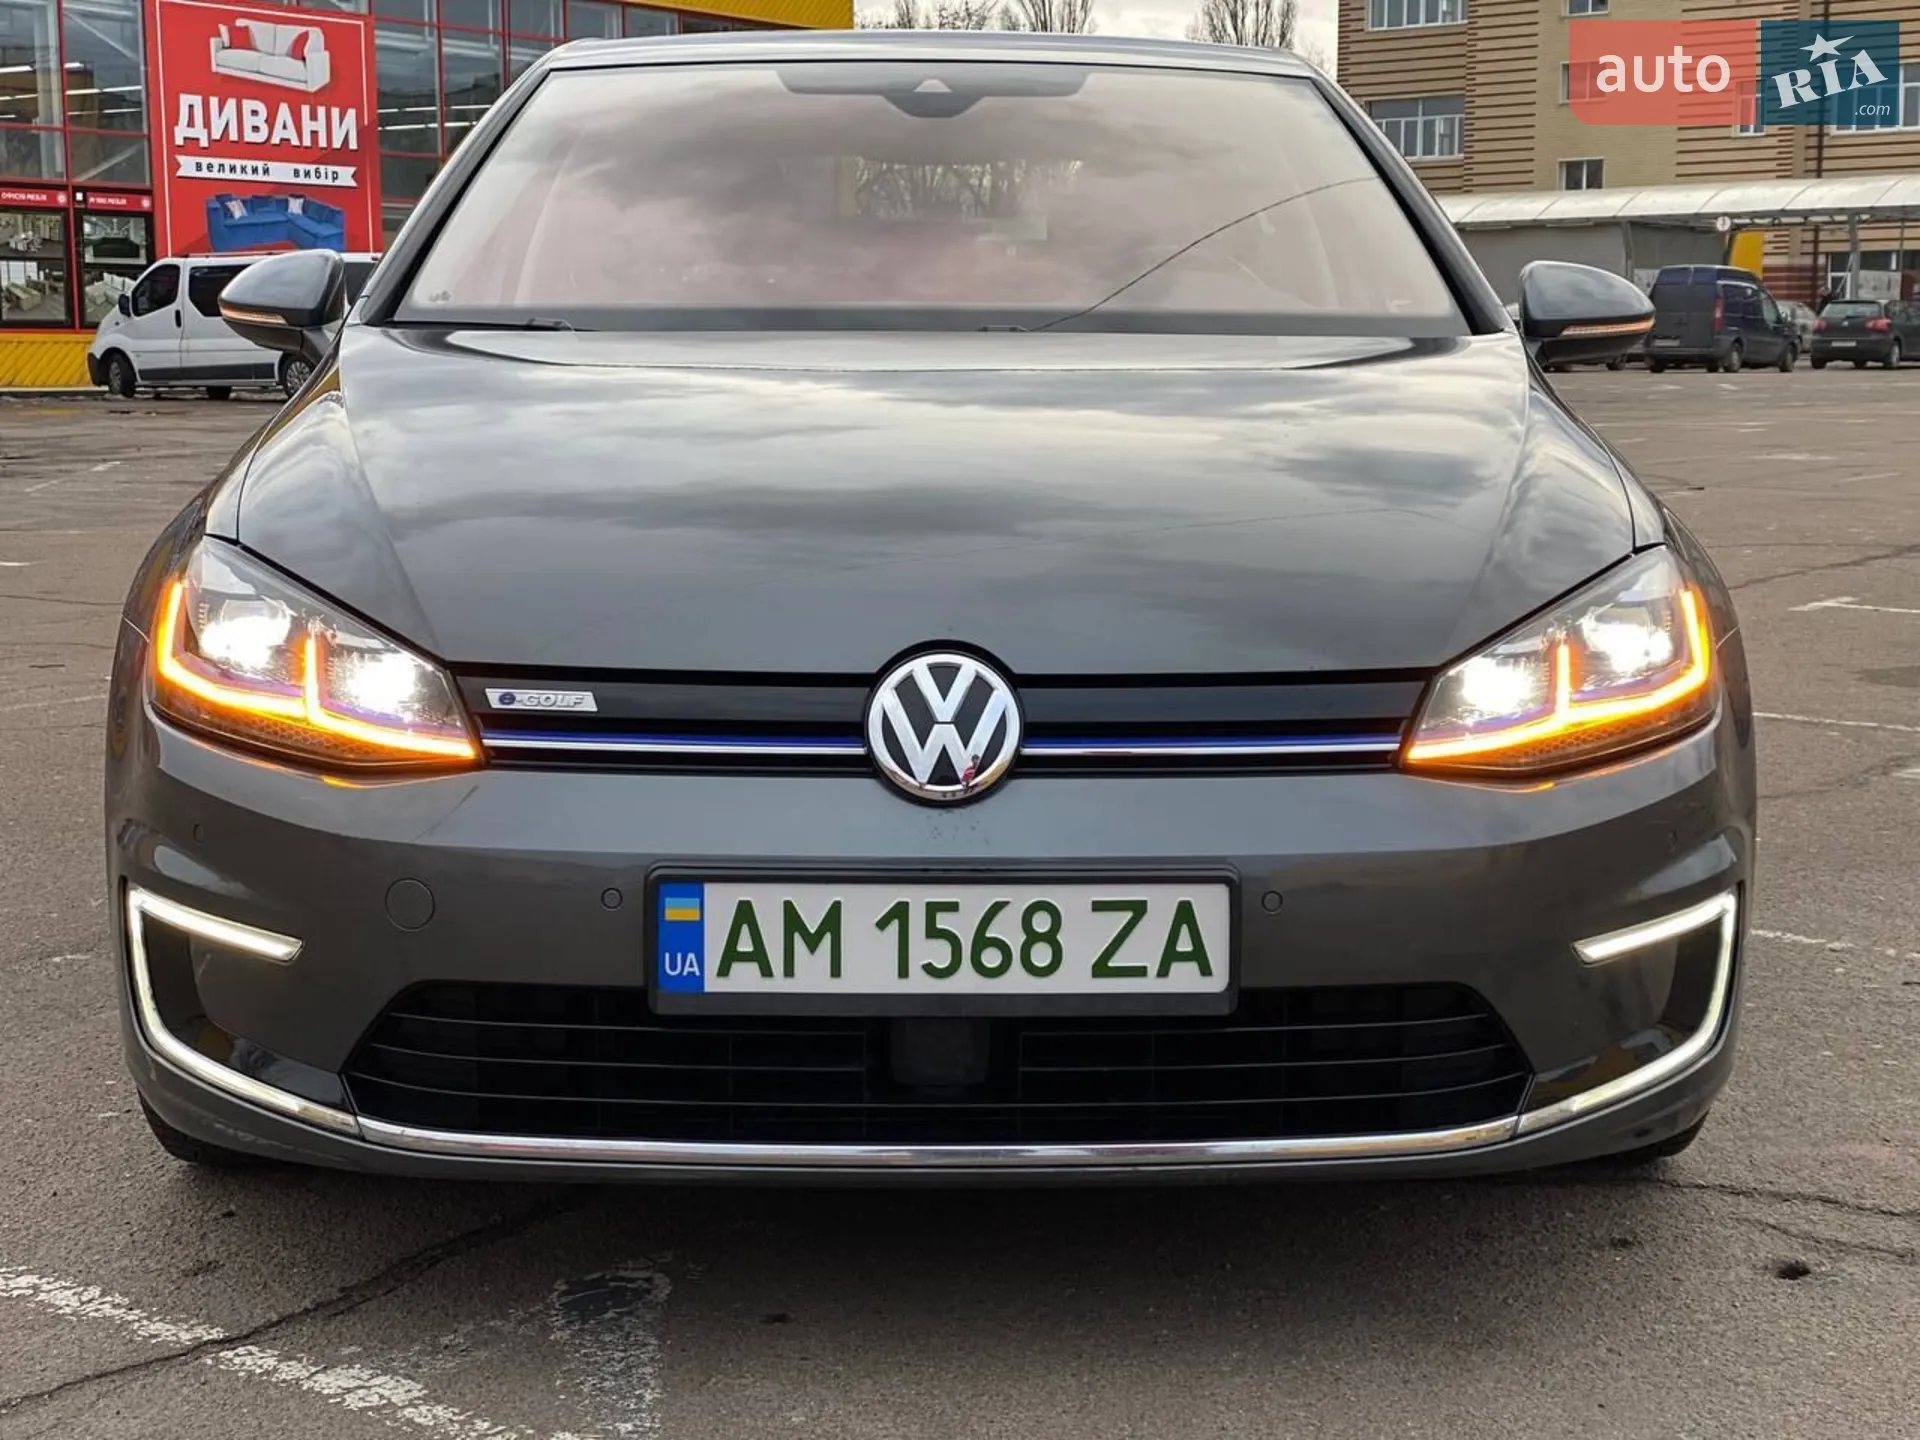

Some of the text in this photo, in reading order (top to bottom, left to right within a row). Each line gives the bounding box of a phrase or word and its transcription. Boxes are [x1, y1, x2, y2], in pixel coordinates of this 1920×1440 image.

[174, 93, 359, 151] ДИВАНИ
[195, 160, 340, 183] великий вибір
[715, 899, 1214, 980] AM 1568 ZA
[664, 952, 701, 977] UA
